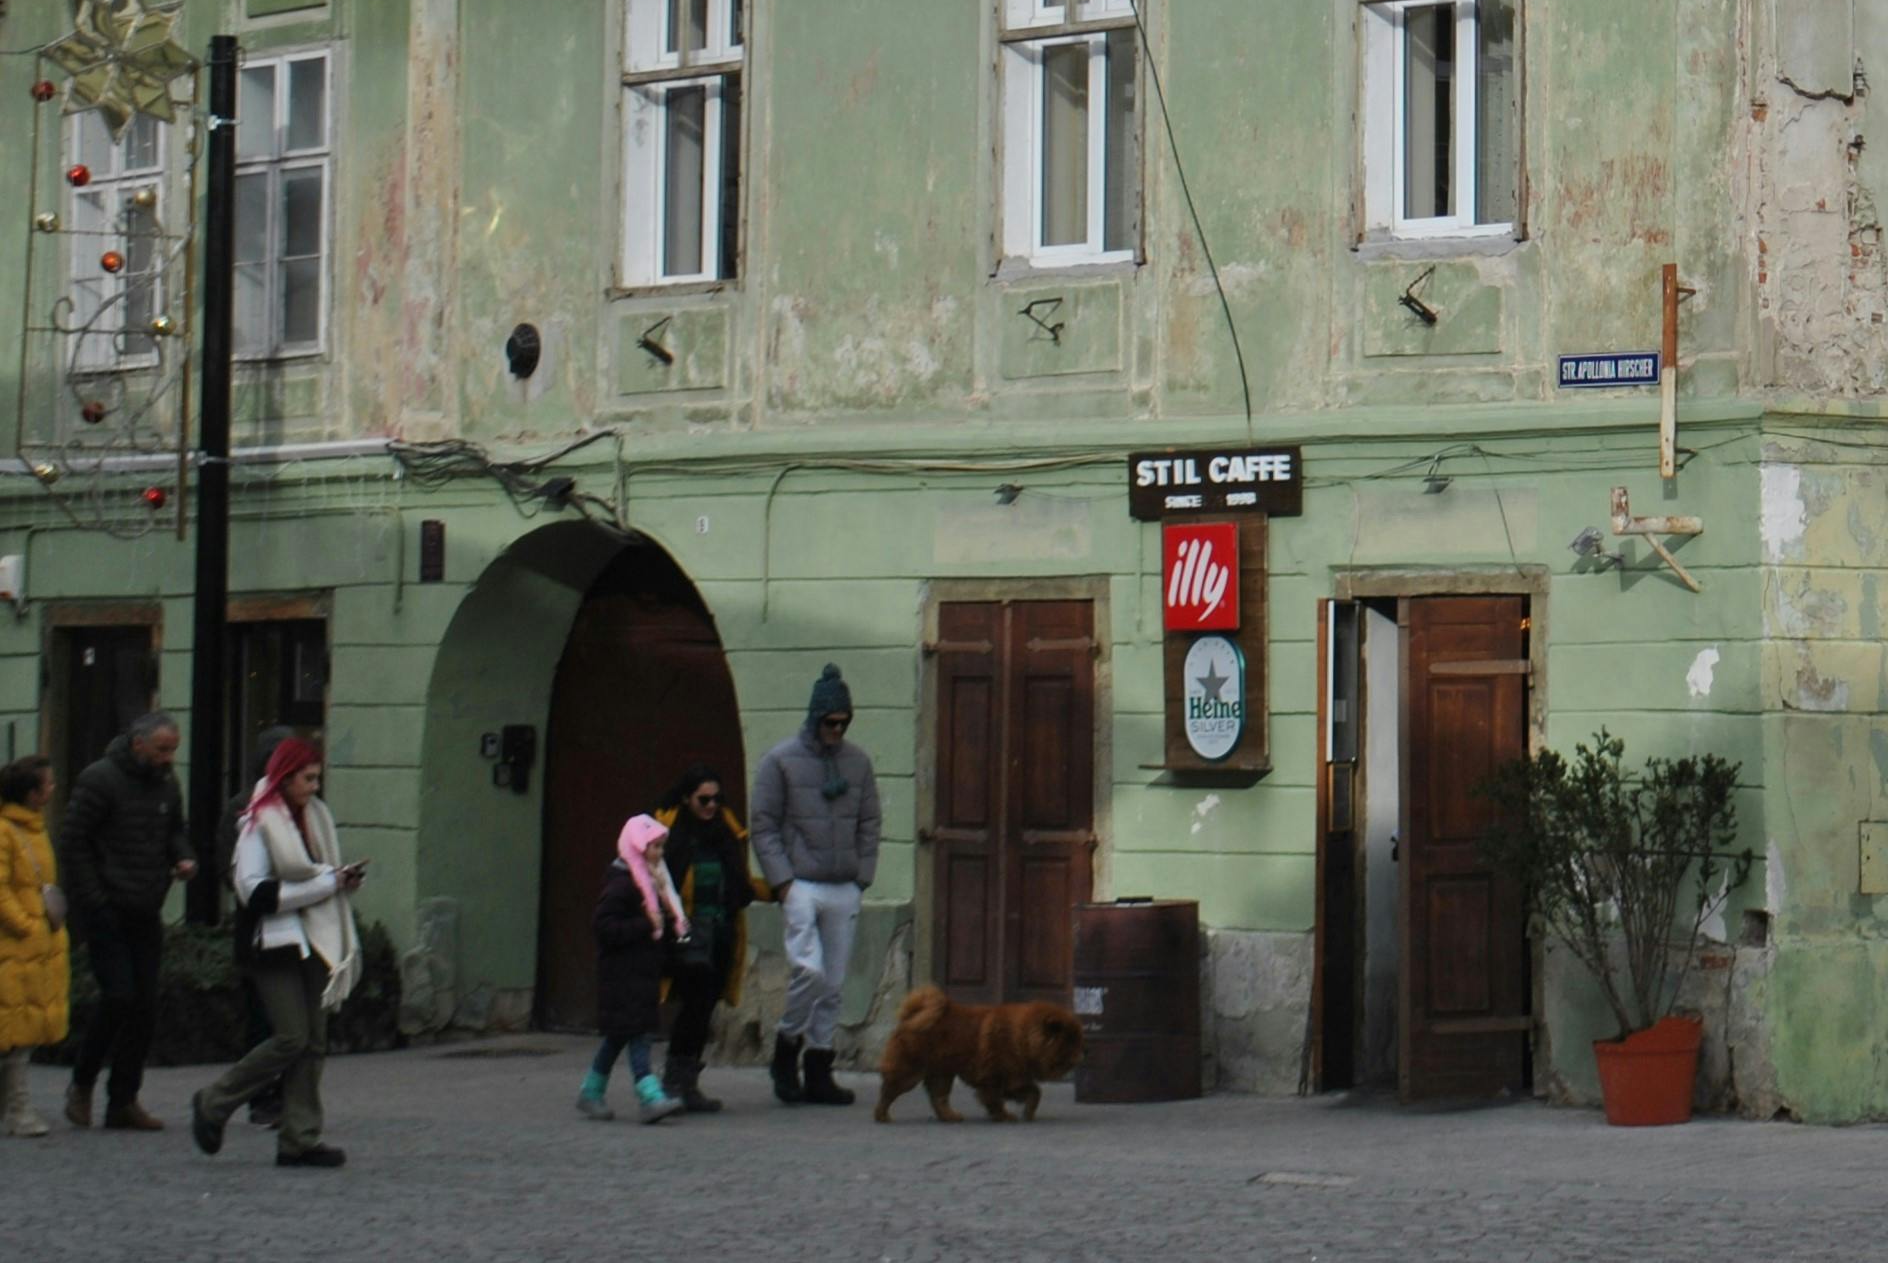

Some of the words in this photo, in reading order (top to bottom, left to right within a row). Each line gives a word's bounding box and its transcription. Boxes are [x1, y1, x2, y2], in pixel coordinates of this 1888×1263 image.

[1617, 358, 1653, 378] HIRSCHER
[1136, 459, 1201, 486] STIL
[1208, 455, 1291, 483] CAFFE
[1168, 538, 1228, 622] illy
[1191, 719, 1236, 733] SILVER
